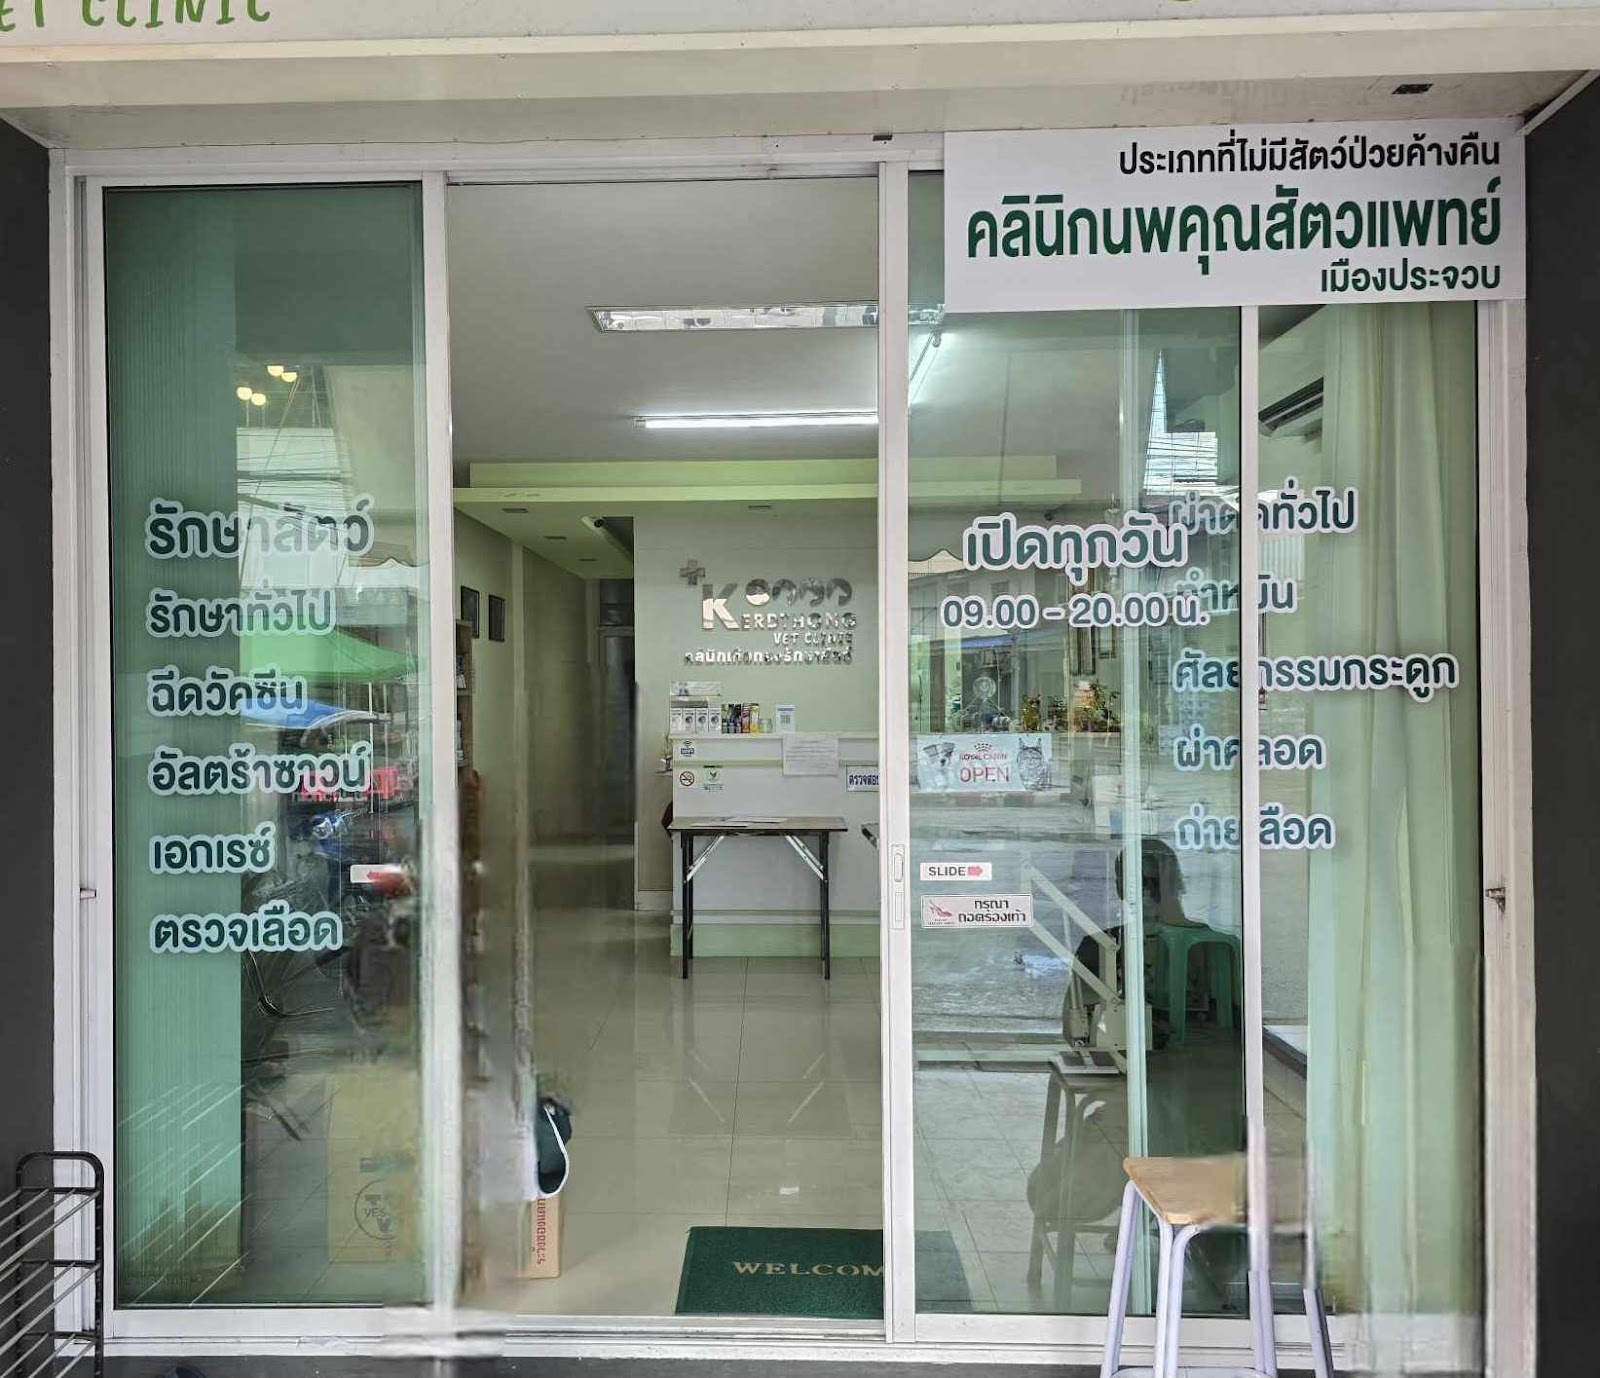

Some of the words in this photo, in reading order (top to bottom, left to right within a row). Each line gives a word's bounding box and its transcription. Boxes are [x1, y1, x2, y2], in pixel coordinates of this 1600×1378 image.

[1118, 129, 1501, 176] ประเภทที่ไม่มีสัตว์ป่วยค้างคืน
[966, 175, 1502, 275] คลินิกนพคุณสัตวแพทย์
[1320, 258, 1501, 293] เมืองประจวบ
[148, 499, 373, 556] รักษาสัตว์
[966, 515, 1187, 582] เปิดทุกวัน
[148, 583, 334, 635] รักษาทั่วไป
[942, 597, 1036, 627] 09.00
[1071, 597, 1166, 627] 20.00
[150, 669, 306, 714] ฉีดวัคซีน
[150, 745, 370, 793] อัลตร้าซาวน์
[959, 766, 1010, 783] OPEN
[152, 826, 273, 871] เอกเรซ์
[928, 865, 967, 877] SLIDE
[154, 904, 340, 950] ตรวจเลือด
[958, 909, 1027, 922] ถอดรองเท้า
[974, 899, 1009, 912] กรุณา
